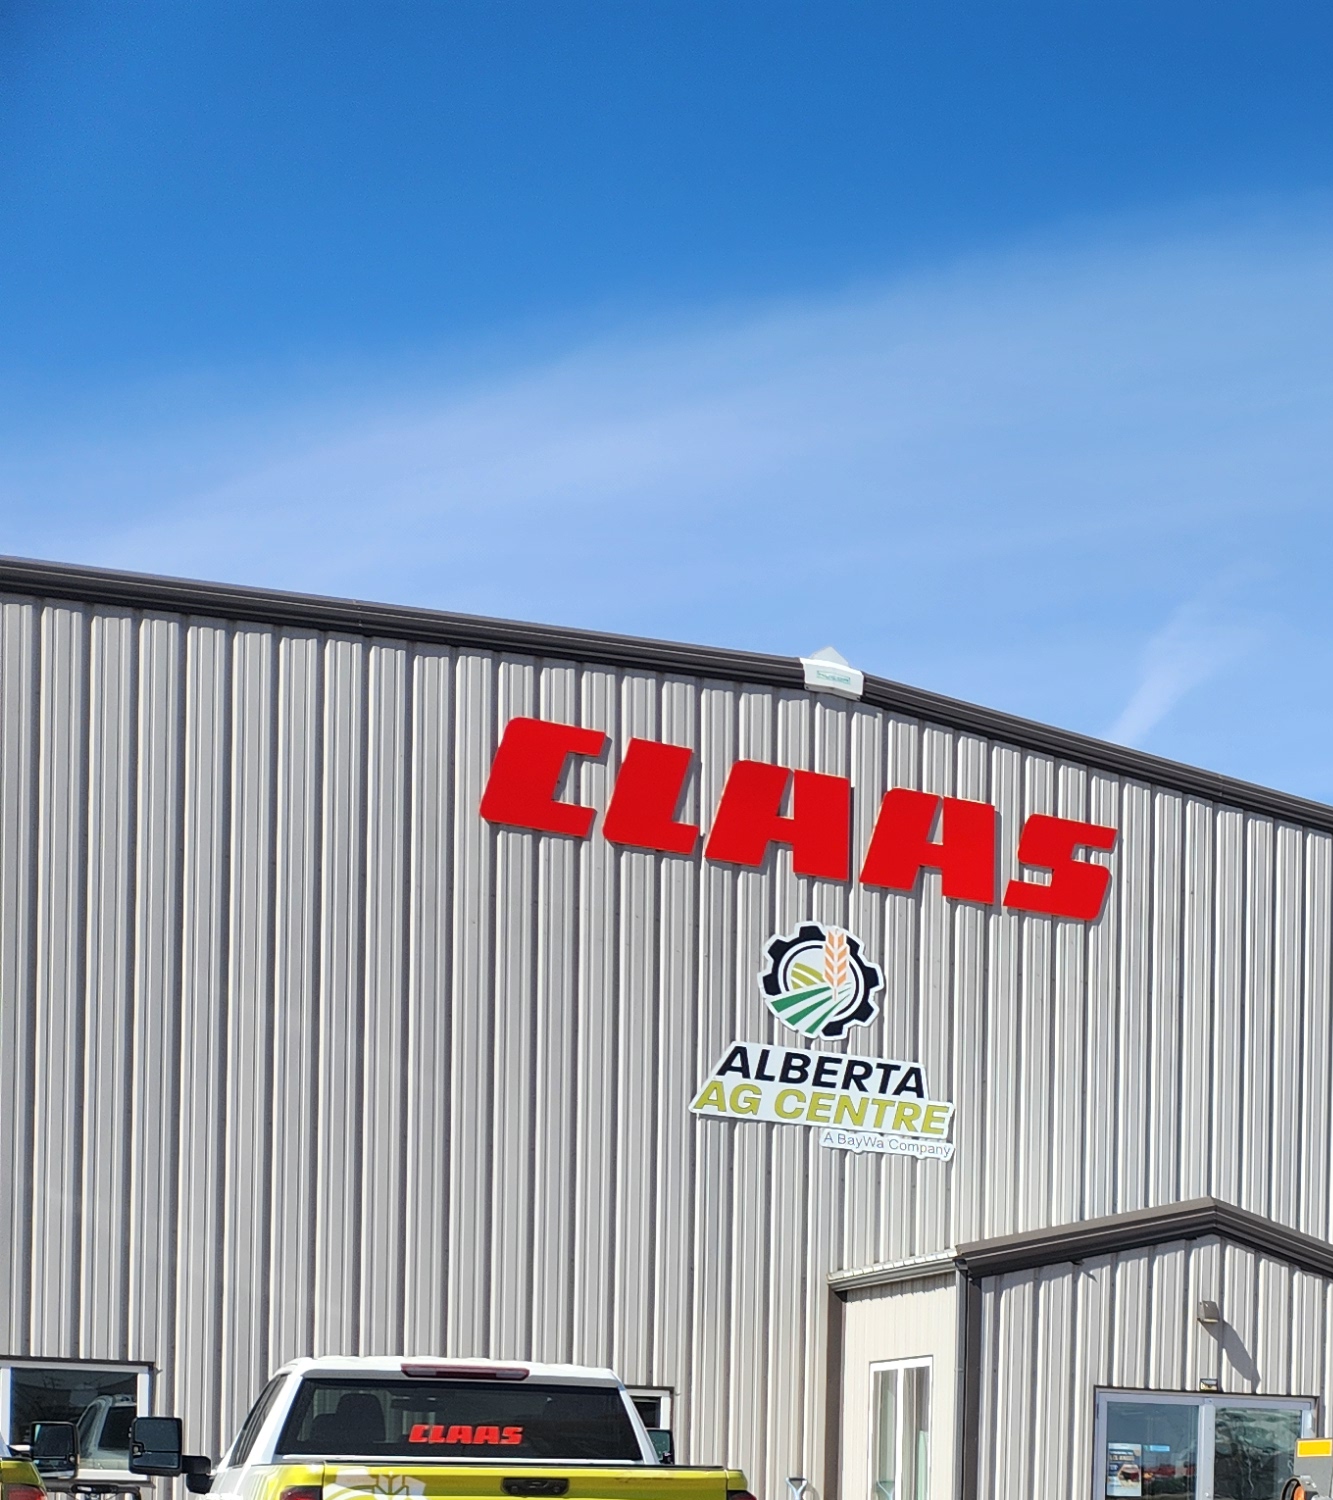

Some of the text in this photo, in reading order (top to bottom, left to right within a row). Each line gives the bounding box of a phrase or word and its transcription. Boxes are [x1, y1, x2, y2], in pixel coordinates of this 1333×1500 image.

[479, 716, 1118, 921] CLAAS
[716, 1045, 925, 1099] ALBERTA
[693, 1080, 951, 1135] AG CENTRE
[824, 1134, 951, 1157] A BayWa Company
[408, 1424, 523, 1445] CLAAS
